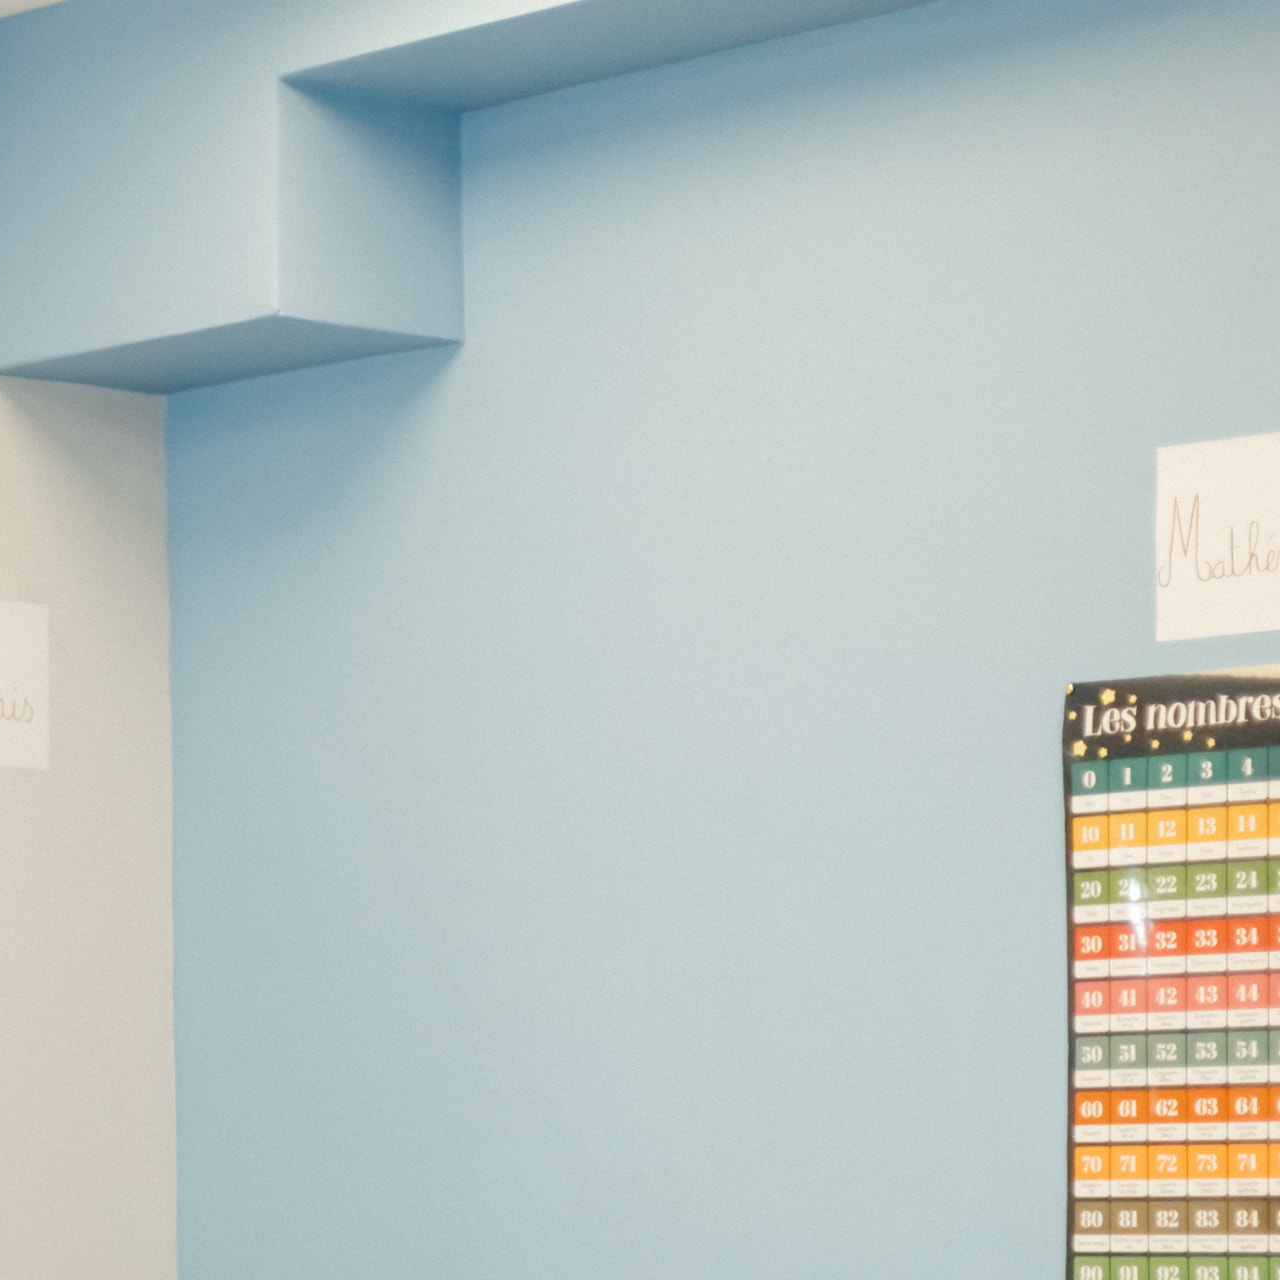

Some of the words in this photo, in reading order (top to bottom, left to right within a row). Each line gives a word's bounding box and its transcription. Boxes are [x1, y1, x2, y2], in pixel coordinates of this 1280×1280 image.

[1158, 491, 1280, 588] Mathé
[1083, 705, 1138, 737] Les
[1083, 771, 1096, 788] 0
[1123, 768, 1131, 785] 1
[1161, 764, 1173, 781] 2
[1201, 762, 1213, 779] 3
[1242, 758, 1253, 775] 4
[1081, 827, 1099, 842] 10
[1121, 824, 1134, 840] 11
[1158, 820, 1176, 837] 12
[1198, 818, 1216, 835] 13
[1238, 815, 1256, 832] 14
[1081, 881, 1101, 898] 20
[1156, 876, 1177, 893] 22
[1196, 874, 1217, 891] 23
[1236, 871, 1257, 888] 24
[1081, 936, 1102, 953] 30
[1156, 932, 1177, 949] 32
[1195, 930, 1217, 947] 33
[1236, 928, 1258, 945] 34
[1081, 991, 1103, 1007] 40
[1119, 989, 1136, 1006] 41
[1155, 987, 1177, 1004] 42
[1195, 986, 1218, 1003] 43
[1236, 985, 1259, 1001] 44
[1081, 1046, 1102, 1063] 50
[1119, 1045, 1136, 1061] 51
[1156, 1043, 1177, 1060] 52
[1196, 1043, 1217, 1059] 53
[1236, 1041, 1258, 1058] 54
[1081, 1101, 1103, 1117] 60
[1118, 1100, 1136, 1117] 61
[1155, 1099, 1178, 1116] 62
[1195, 1098, 1218, 1115] 63
[1235, 1097, 1259, 1114] 64
[1082, 1156, 1102, 1172] 70
[1120, 1155, 1136, 1172] 71
[1157, 1155, 1177, 1172] 72
[1197, 1154, 1217, 1171] 73
[1238, 1154, 1256, 1171] 74
[1080, 1210, 1103, 1227] 80
[1119, 1210, 1138, 1227] 81
[1156, 1210, 1179, 1227] 82
[1196, 1210, 1219, 1227] 83
[1236, 1210, 1259, 1227] 84
